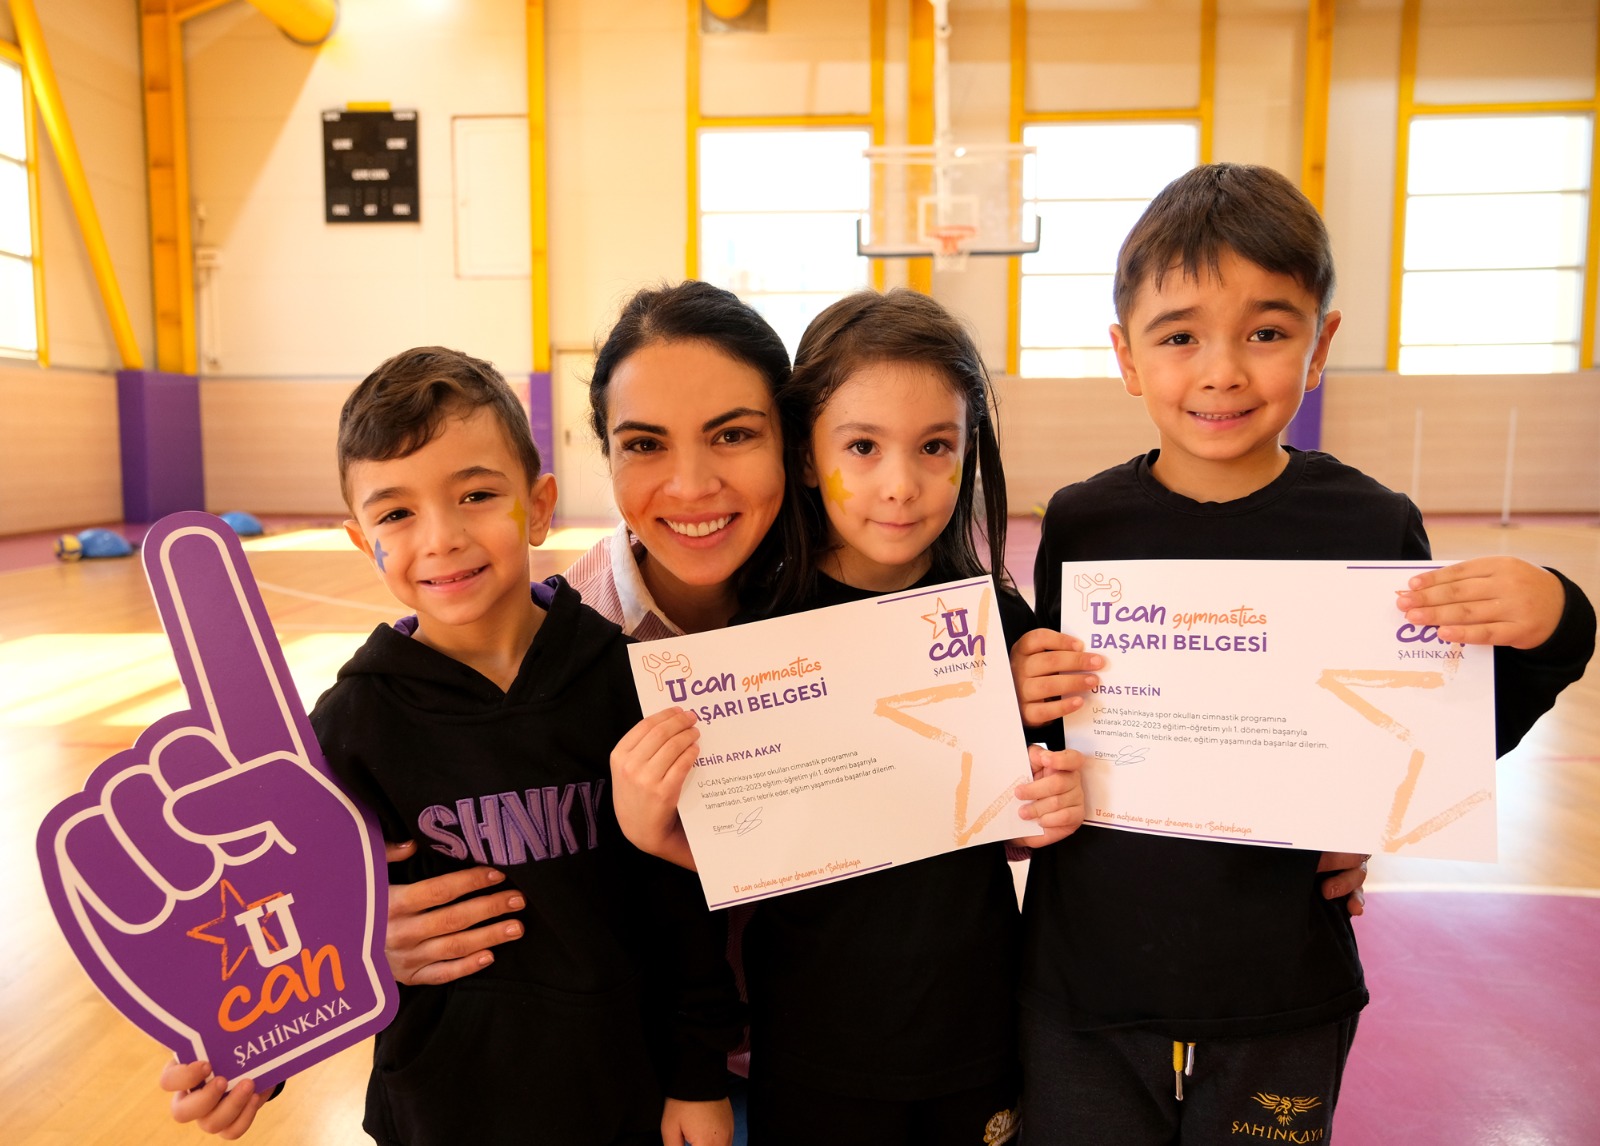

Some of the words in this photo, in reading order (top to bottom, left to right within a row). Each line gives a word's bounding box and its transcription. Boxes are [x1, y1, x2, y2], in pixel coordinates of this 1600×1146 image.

[941, 609, 969, 639] U
[1090, 601, 1112, 625] U
[1115, 604, 1166, 626] can
[1172, 605, 1267, 631] gymnastics
[929, 634, 986, 662] can
[1090, 633, 1167, 654] BAŞARI
[1173, 631, 1267, 653] BELGESİ
[1396, 623, 1465, 648] ca
[665, 677, 688, 702] U
[691, 672, 736, 696] can
[741, 656, 822, 692] gymnastics
[1124, 683, 1161, 697] TEKİN
[747, 677, 828, 713] BELGESİ
[1093, 717, 1121, 726] katılarak
[1122, 719, 1161, 730] 2022-2023
[1162, 723, 1220, 733] eğitim-öğretim
[1240, 726, 1270, 734] dönemi
[1272, 727, 1307, 738] başarıyla
[1119, 708, 1154, 719] Şahinkaya
[1155, 711, 1171, 719] spor
[1202, 713, 1239, 721] cimnastik
[1240, 714, 1287, 724] programına
[1136, 731, 1151, 740] Seni
[1152, 734, 1172, 742] tebrik
[1194, 736, 1218, 745] eğitim
[1219, 738, 1261, 747] yaşamında
[692, 753, 724, 768] NEHİR
[725, 750, 753, 763] ARYA
[754, 743, 782, 758] AKAY
[697, 780, 721, 789] U-CAN
[753, 771, 767, 779] spor
[790, 758, 821, 771] cimnastik
[821, 751, 858, 765] programına
[728, 782, 762, 795] 2022-2023
[824, 764, 848, 775] dönemi
[848, 756, 877, 769] başarıyla
[742, 794, 756, 804] Seni
[756, 791, 774, 801] tebrik
[790, 784, 810, 794] eğitim
[810, 776, 844, 791] yaşamında
[417, 778, 606, 866] SHNKY
[1102, 811, 1115, 819] can
[1145, 817, 1162, 826] your
[1164, 817, 1193, 829] dreams
[740, 884, 752, 892] can
[778, 875, 792, 886] your
[234, 892, 302, 968] U
[217, 943, 346, 1033] can
[233, 996, 352, 1068] ŞAHİNKAYA
